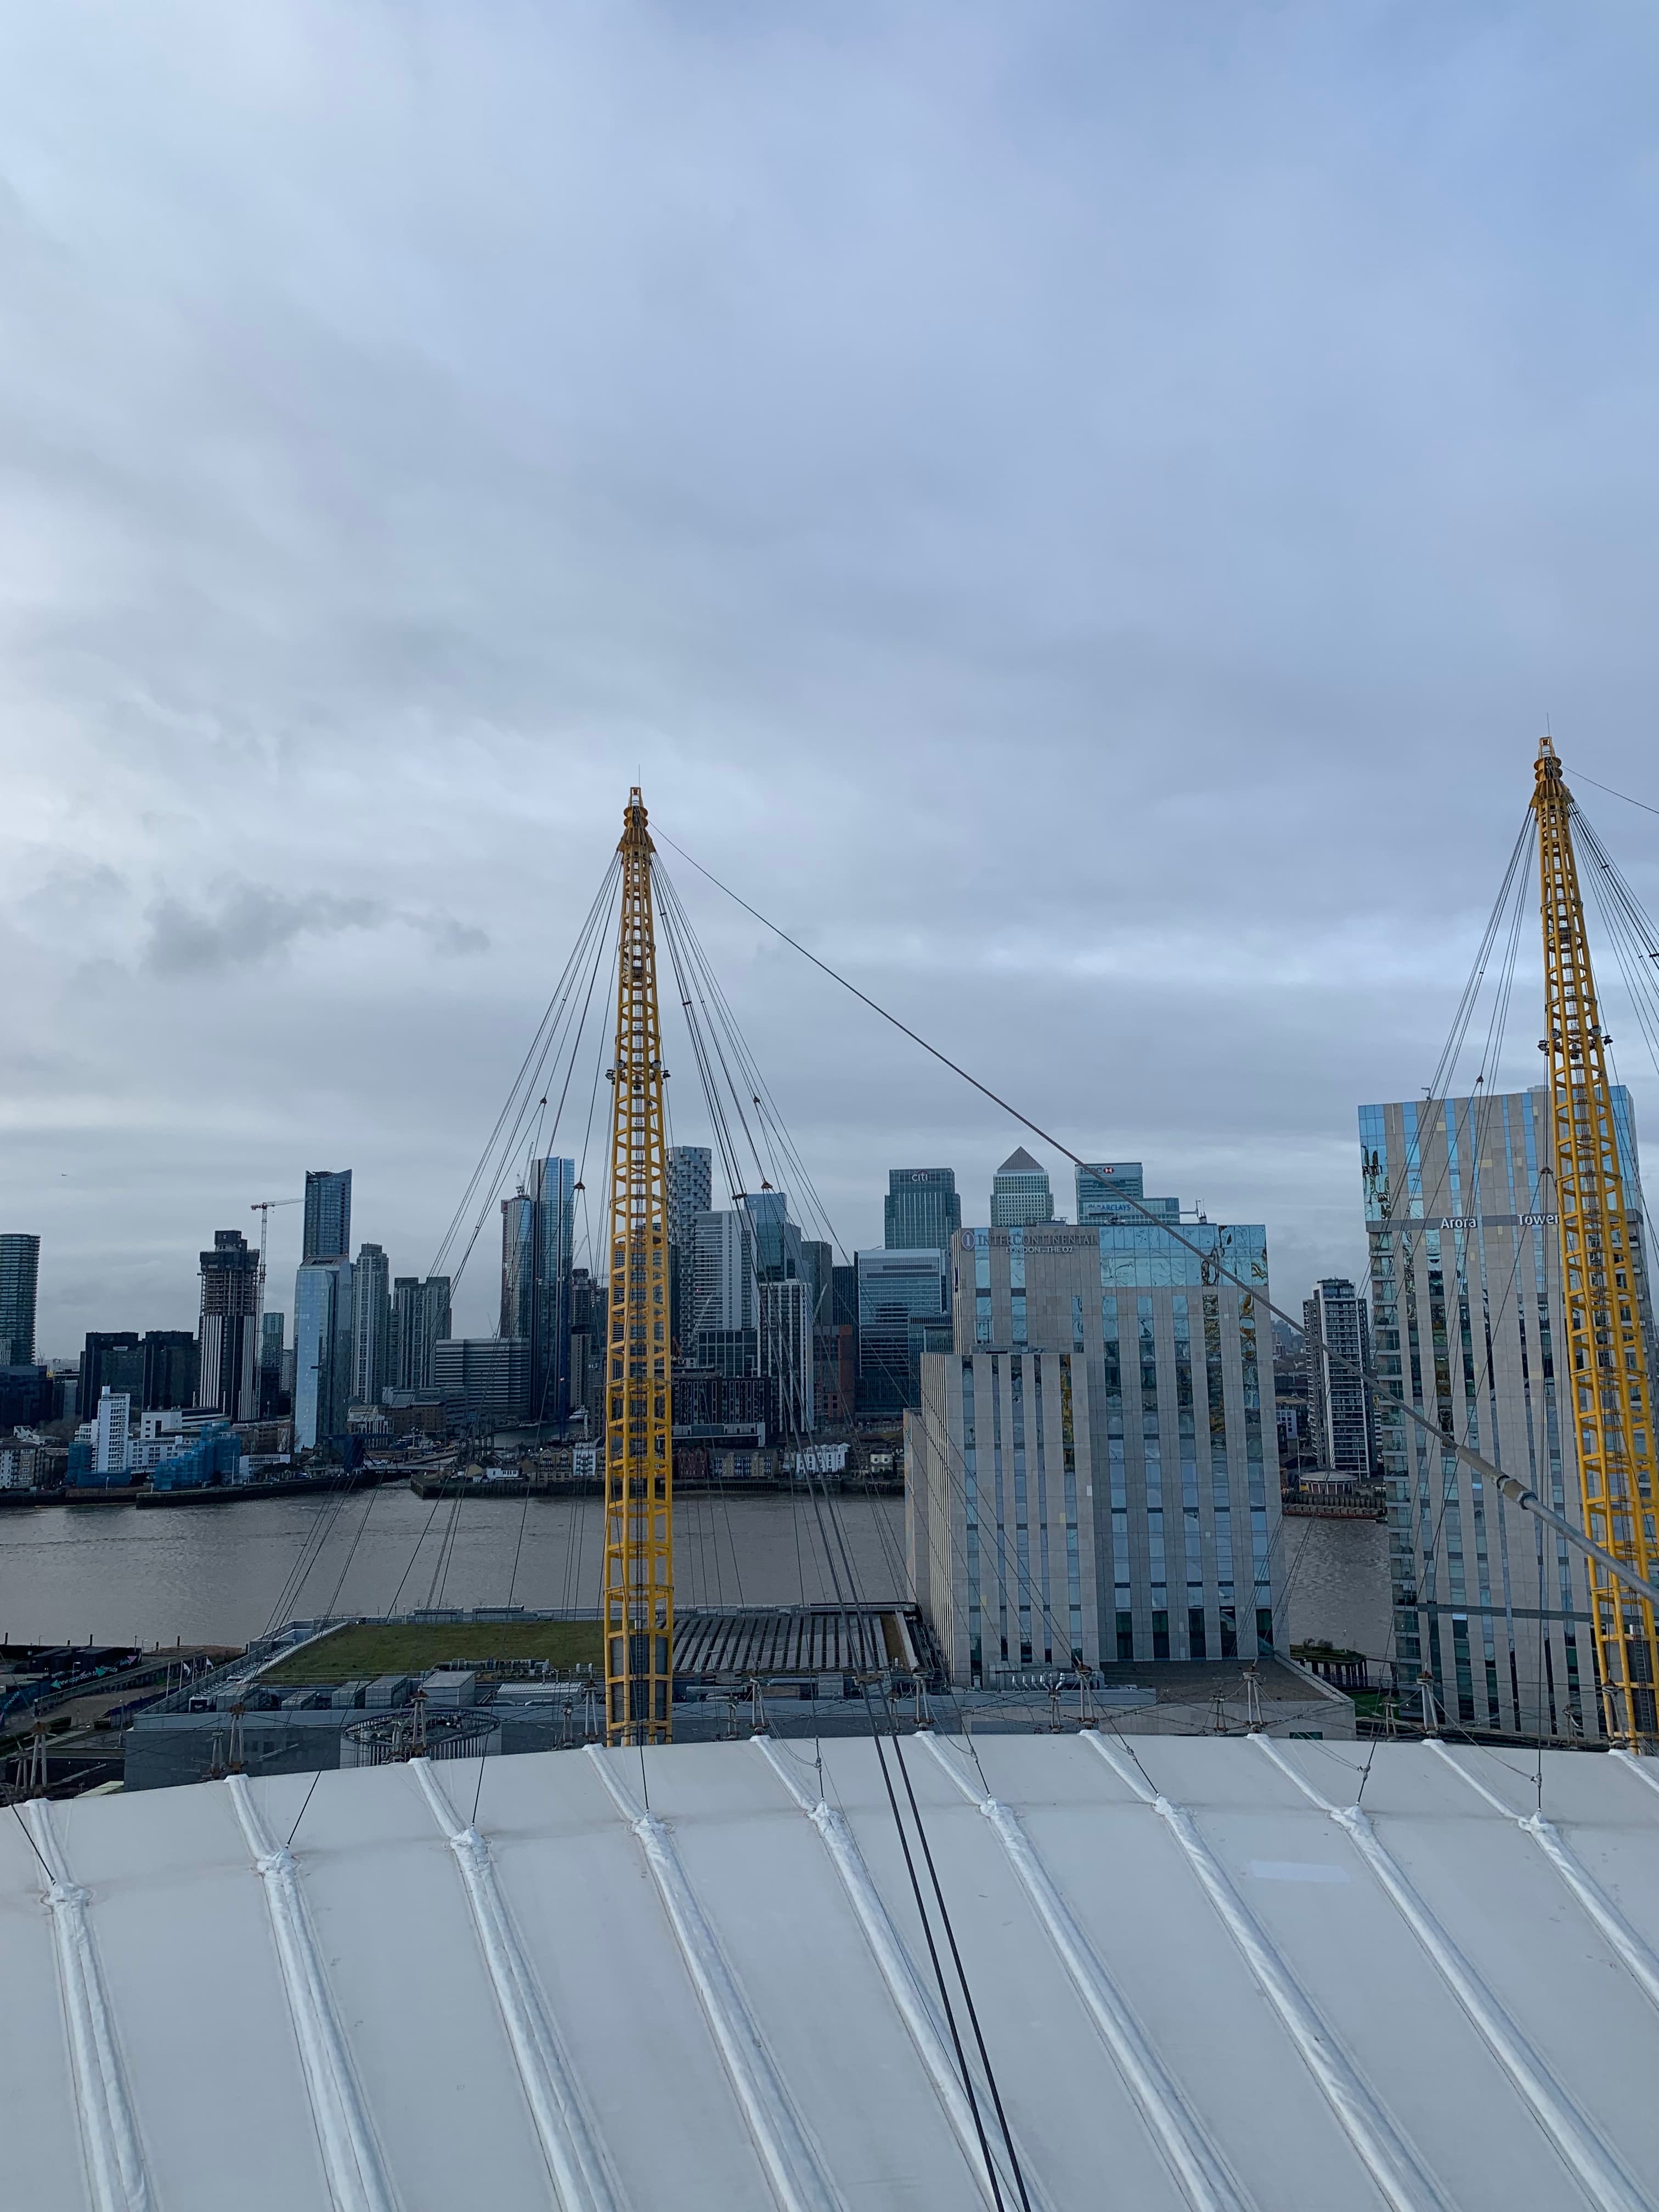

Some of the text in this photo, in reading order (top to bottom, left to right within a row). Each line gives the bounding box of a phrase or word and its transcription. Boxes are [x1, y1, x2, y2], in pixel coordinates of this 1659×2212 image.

[912, 1172, 928, 1182] citi
[1441, 1214, 1559, 1229] Arora Tower
[69, 1671, 92, 1683] approach
